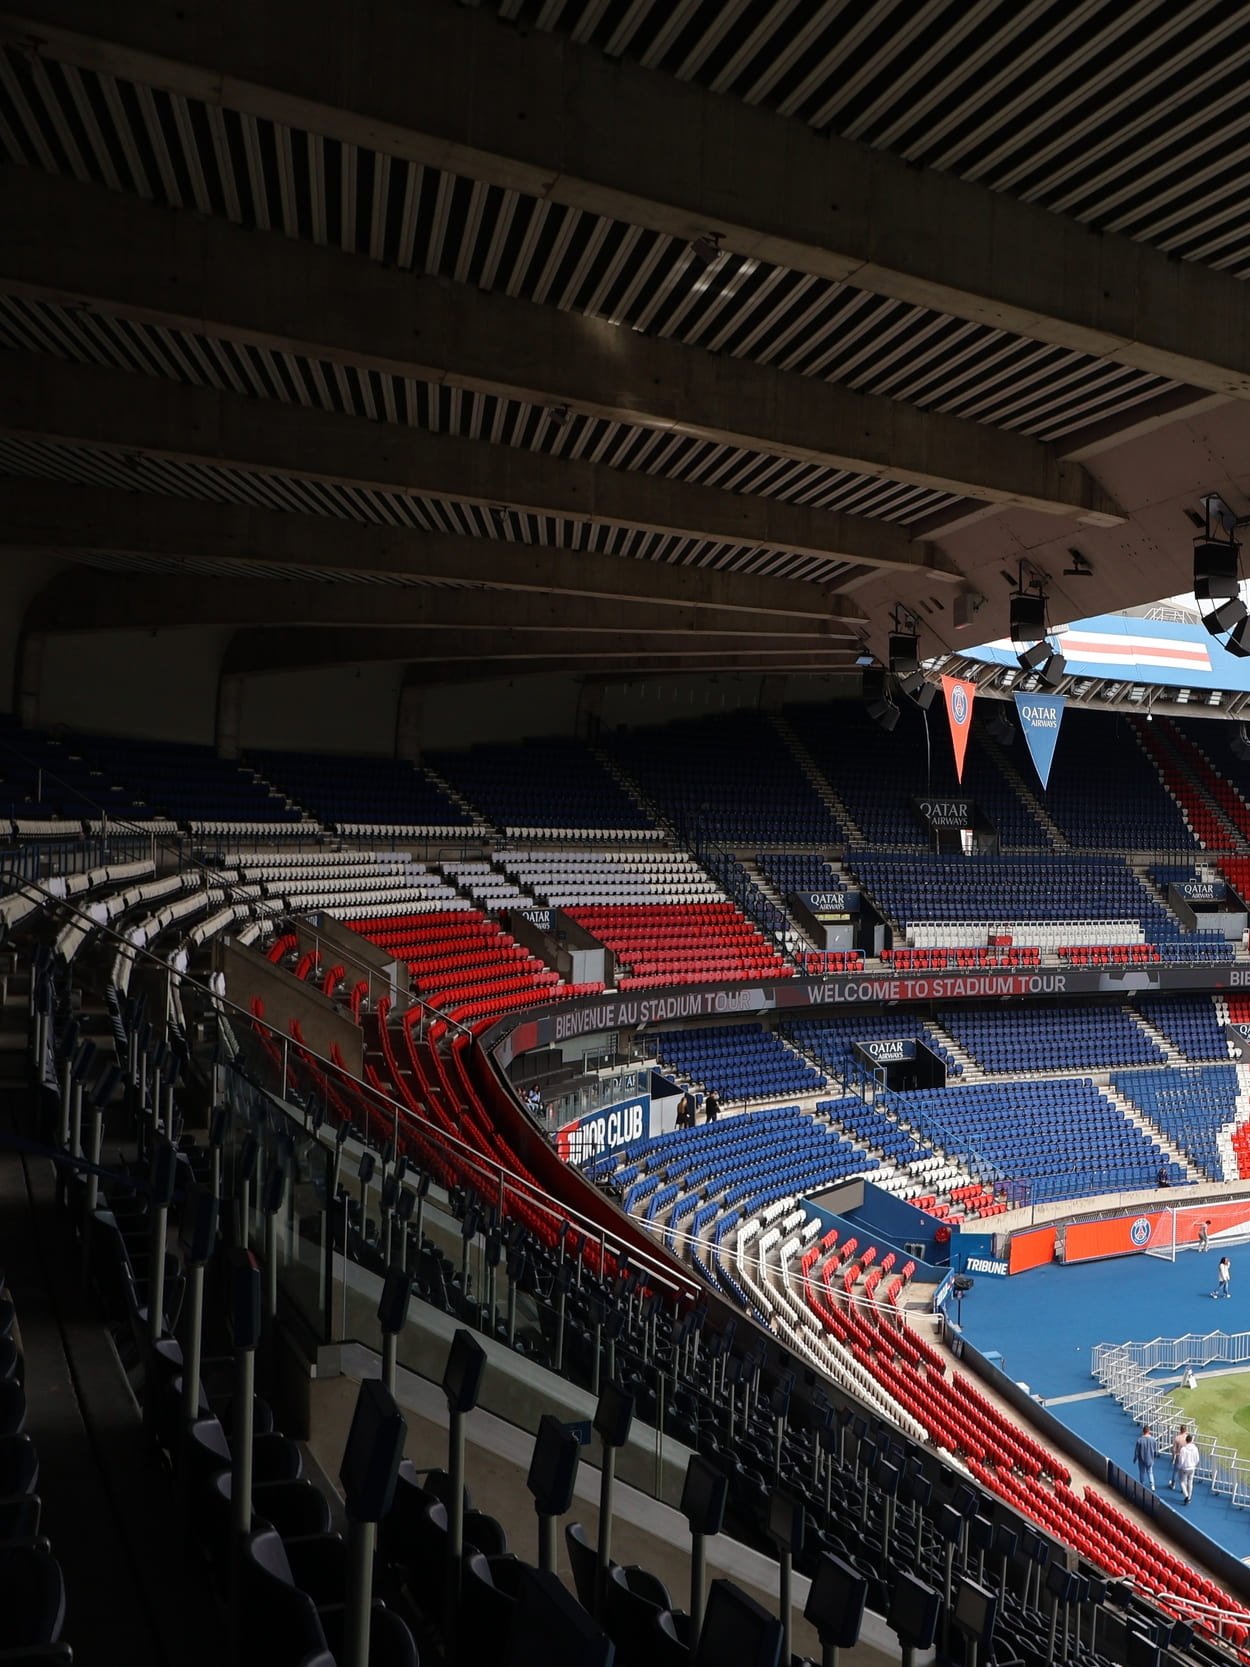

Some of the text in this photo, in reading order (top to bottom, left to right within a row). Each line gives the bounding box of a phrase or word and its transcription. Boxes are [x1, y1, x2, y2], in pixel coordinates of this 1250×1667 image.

[1022, 706, 1056, 721] QATAR
[1031, 719, 1057, 728] AIRWAYS
[920, 802, 967, 819] QATAR
[931, 817, 967, 826] AIRWAYS
[1184, 884, 1213, 895] QATAR
[811, 893, 844, 905] QATAR
[820, 903, 844, 911] AIRWAYS
[807, 975, 1065, 1004] WELCOME TO STADIUM TOUR
[556, 991, 752, 1039] BIENVENUE AU STADIUM TOUR
[870, 1042, 903, 1055] QATAR
[878, 1052, 903, 1060] AIRWAYS
[608, 1105, 643, 1148] CLUB
[967, 1257, 1009, 1275] TRIBUNE
